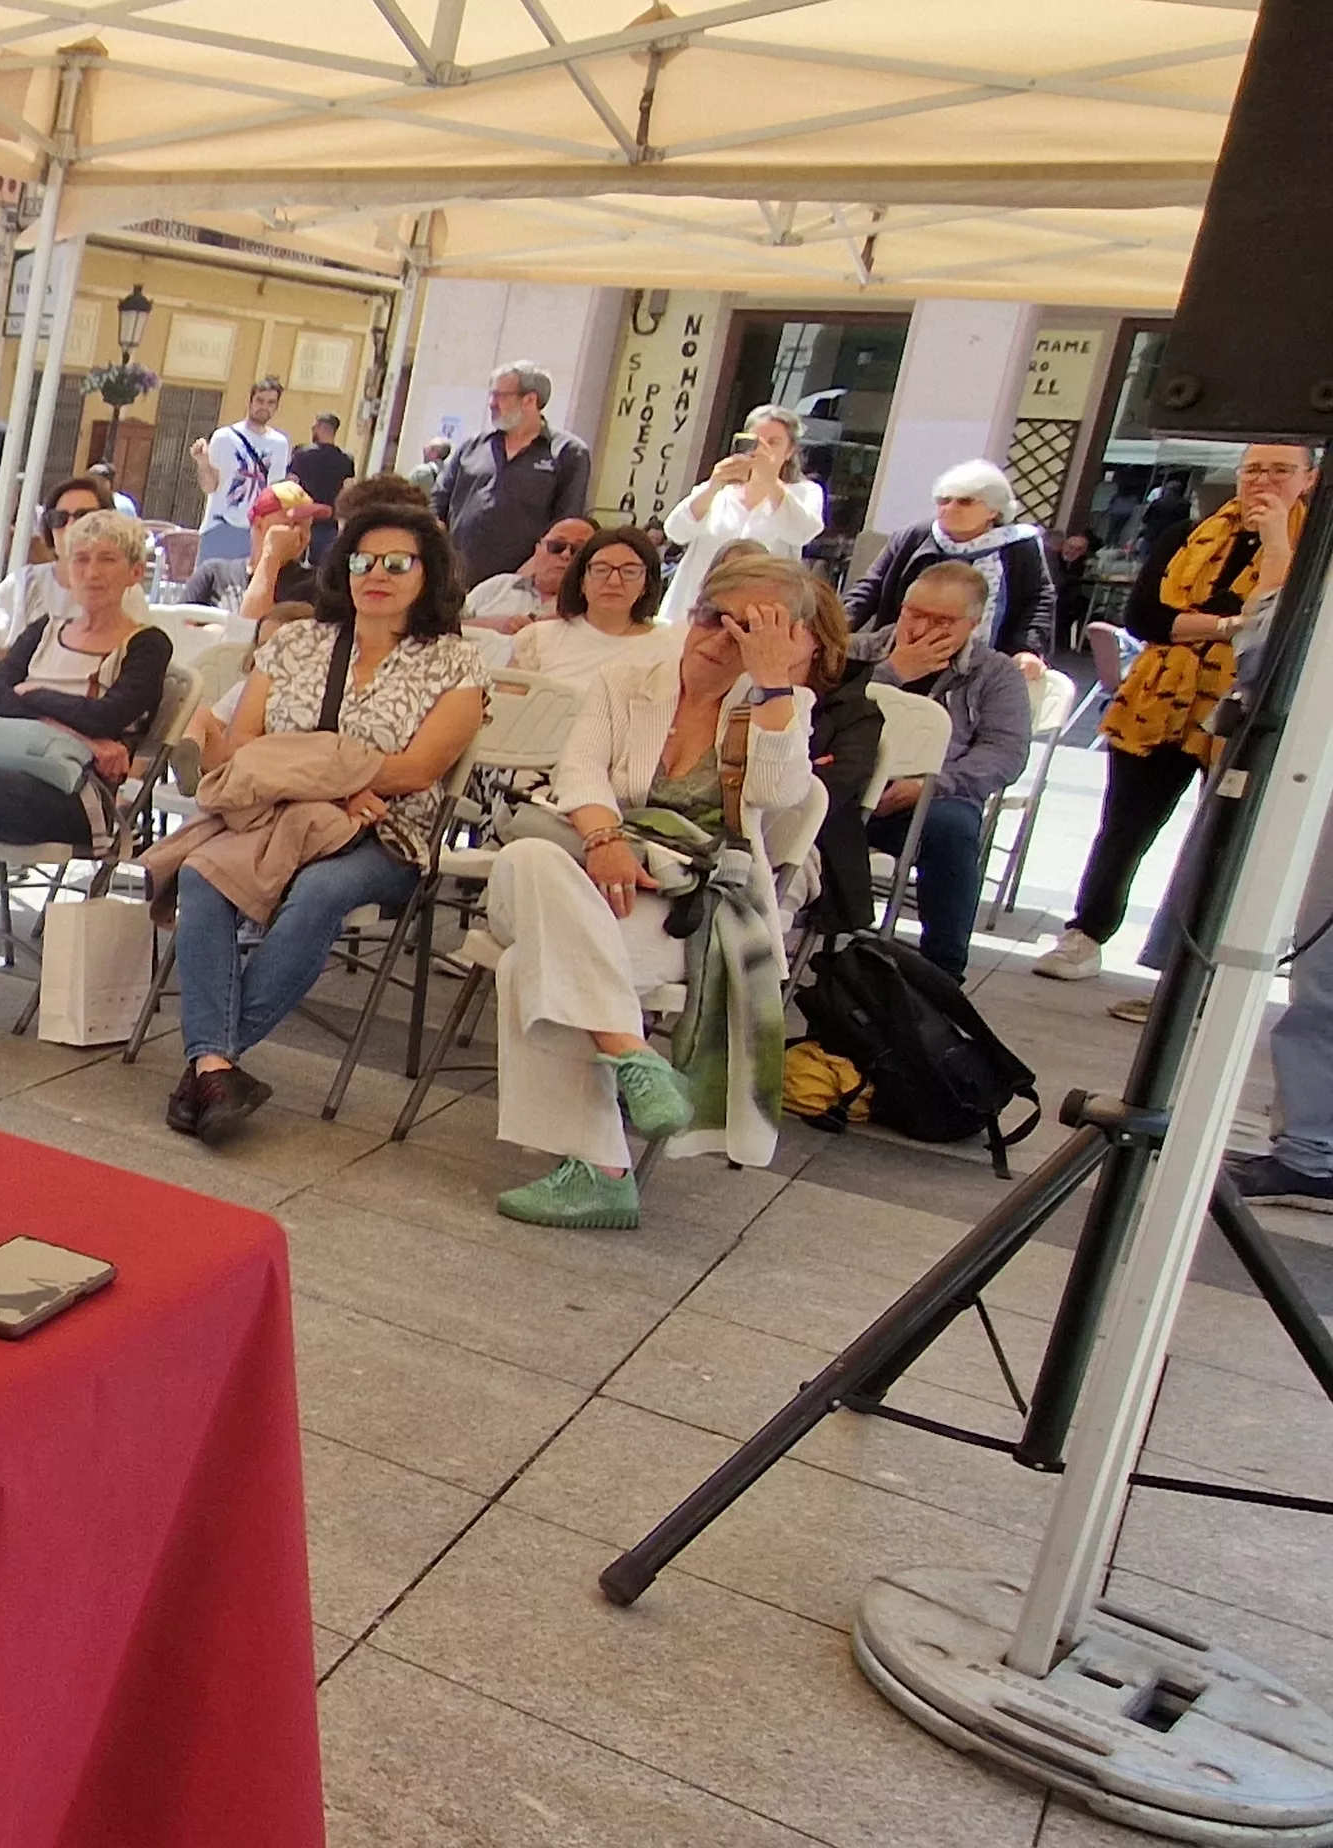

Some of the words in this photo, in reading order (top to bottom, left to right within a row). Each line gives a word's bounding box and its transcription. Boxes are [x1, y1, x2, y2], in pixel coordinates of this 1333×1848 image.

[681, 314, 703, 358] NO
[617, 353, 641, 416] SIN
[673, 367, 698, 433] HAY
[619, 383, 661, 511] POESIA
